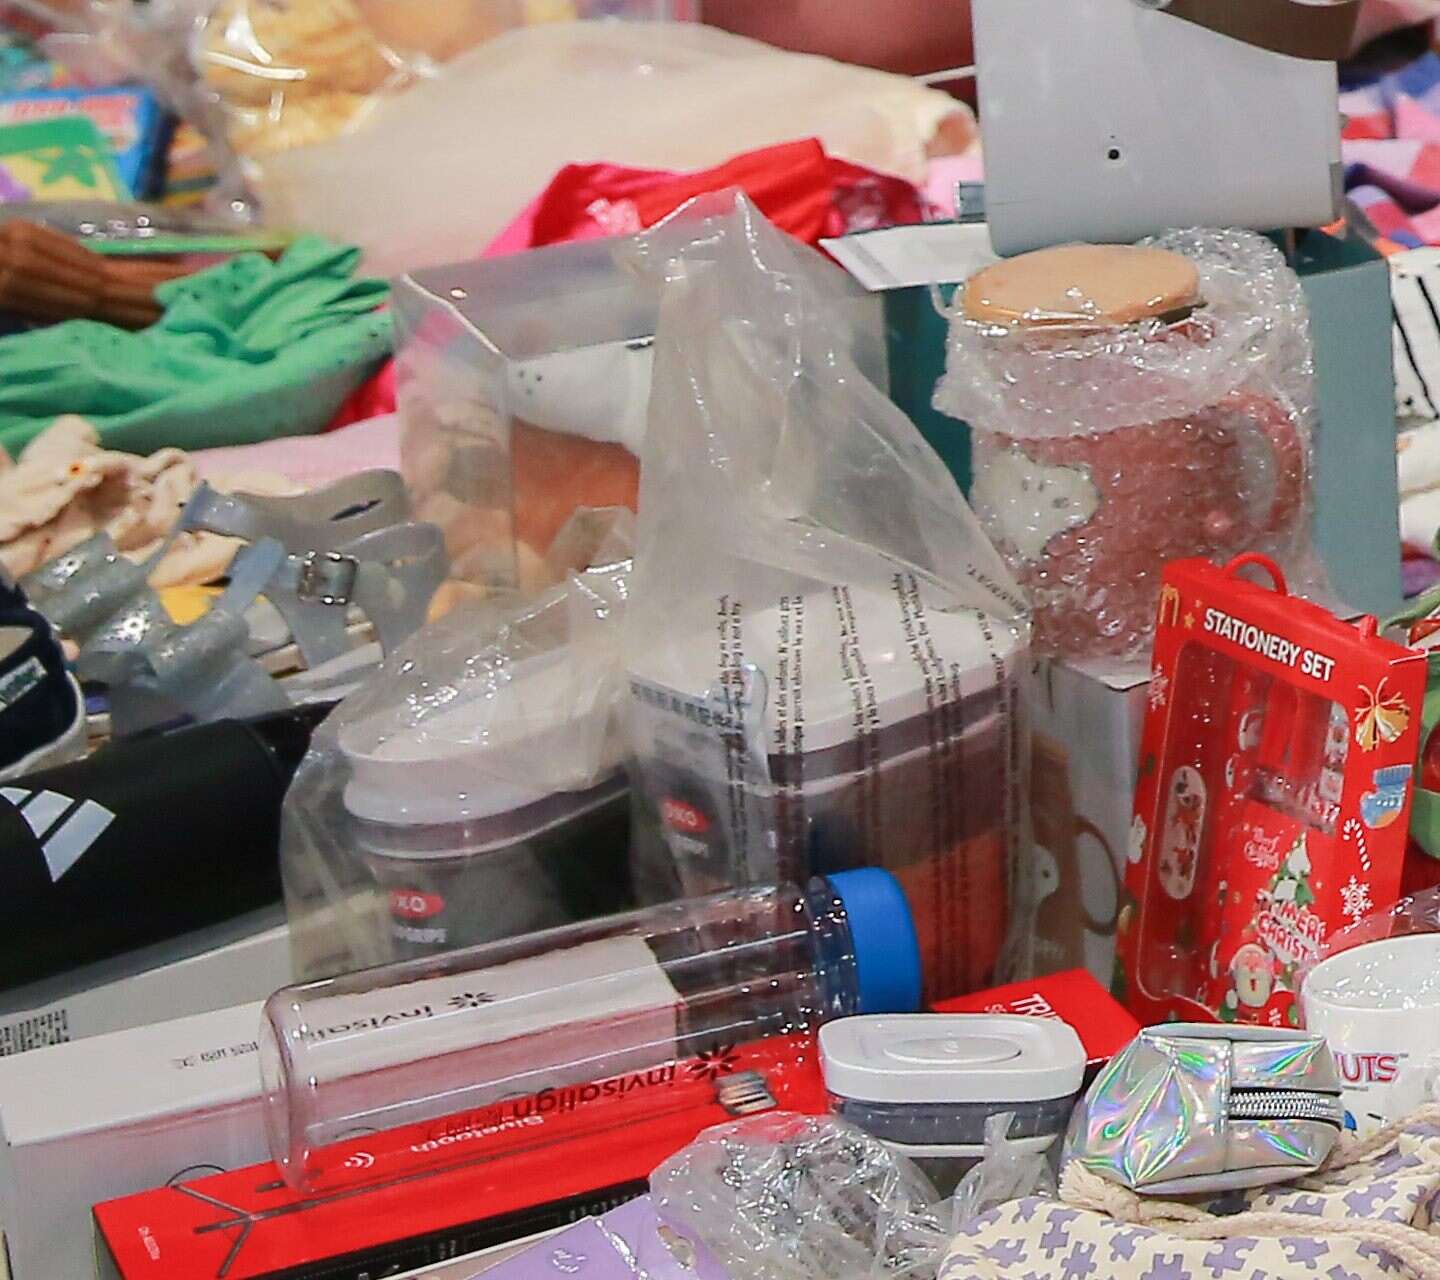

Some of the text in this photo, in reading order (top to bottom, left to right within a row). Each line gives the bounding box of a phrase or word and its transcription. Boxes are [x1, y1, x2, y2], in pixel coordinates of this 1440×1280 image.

[1203, 607, 1336, 683] STATIONERY SET
[512, 1060, 677, 1122] invisalign
[411, 1115, 545, 1154] Bluetooth
